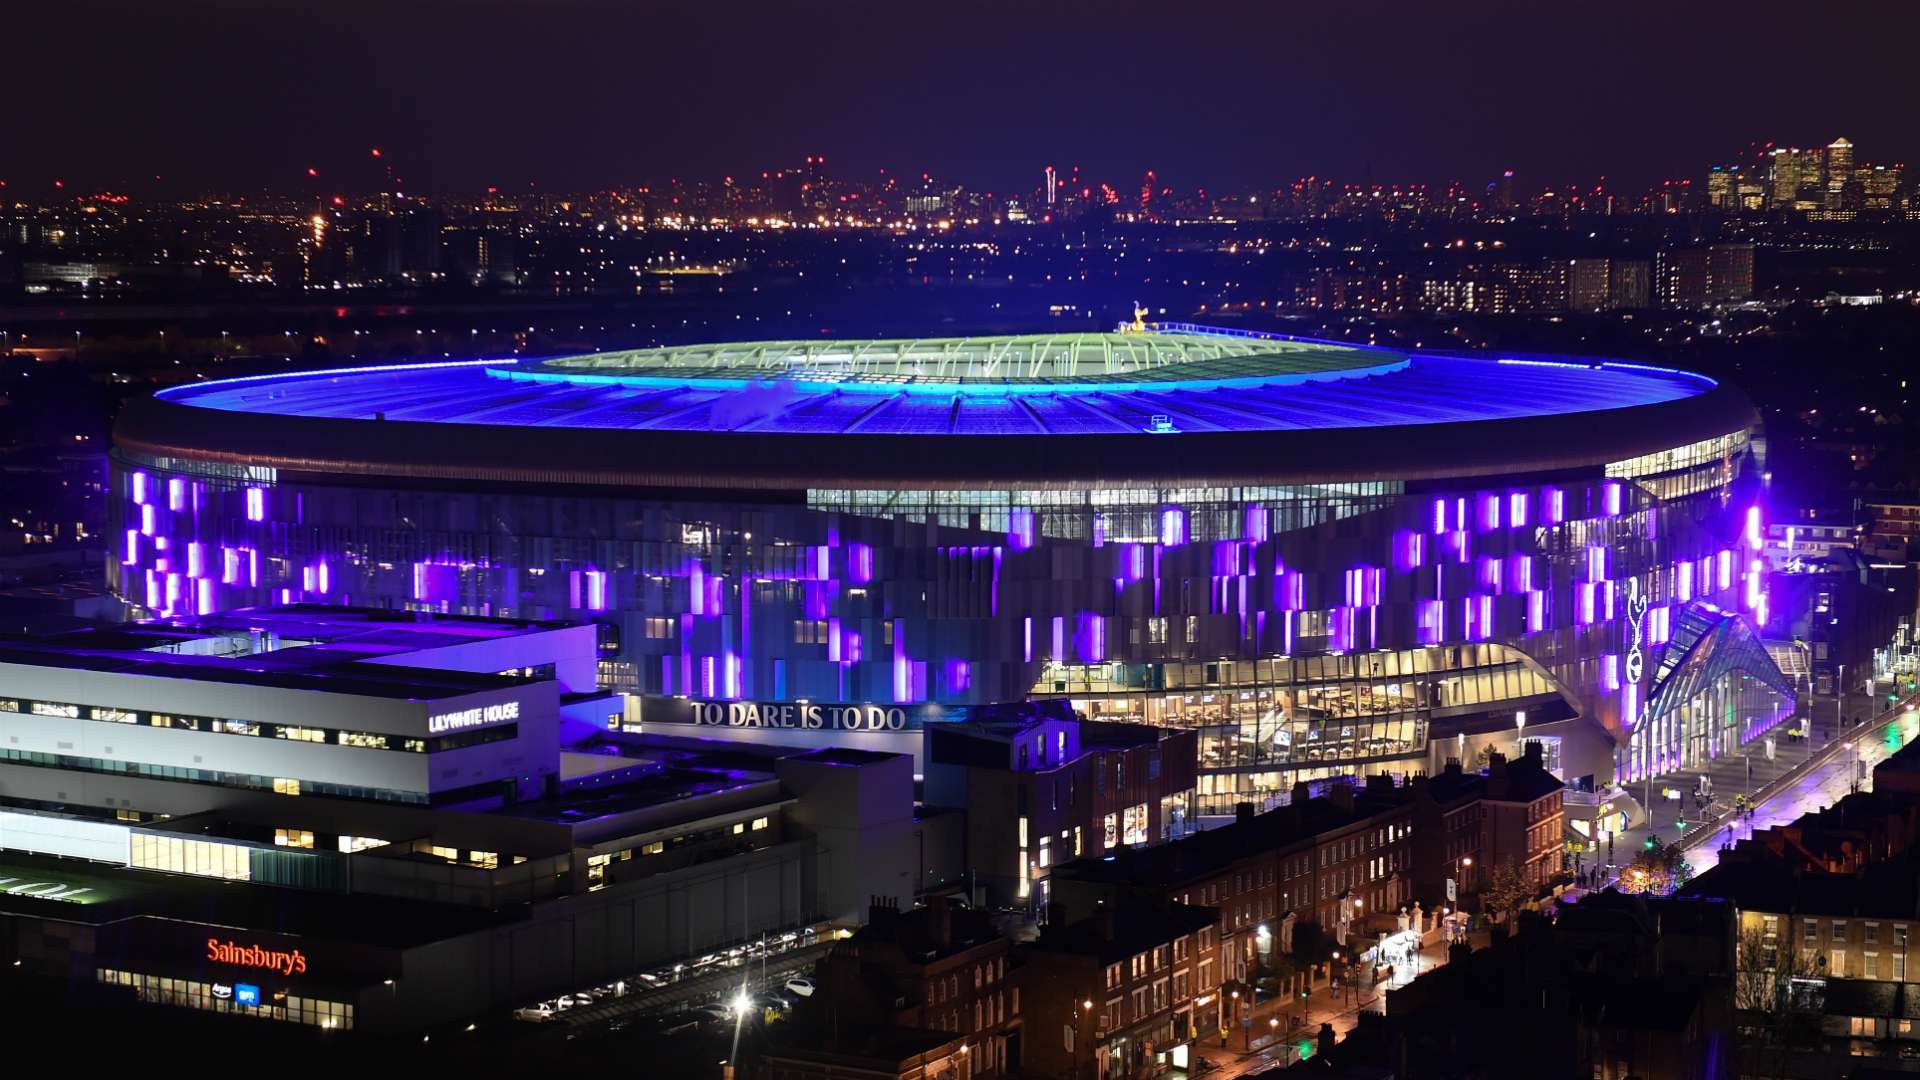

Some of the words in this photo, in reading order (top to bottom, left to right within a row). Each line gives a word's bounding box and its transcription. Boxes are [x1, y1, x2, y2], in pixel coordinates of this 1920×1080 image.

[429, 708, 483, 733] LILYWHITE
[483, 702, 519, 723] HOUSE
[690, 702, 723, 726] TO
[728, 702, 795, 728] DARE
[800, 705, 823, 729] IS
[828, 707, 861, 730] TO
[867, 706, 906, 730] DO
[207, 939, 306, 976] Sainsbury's
